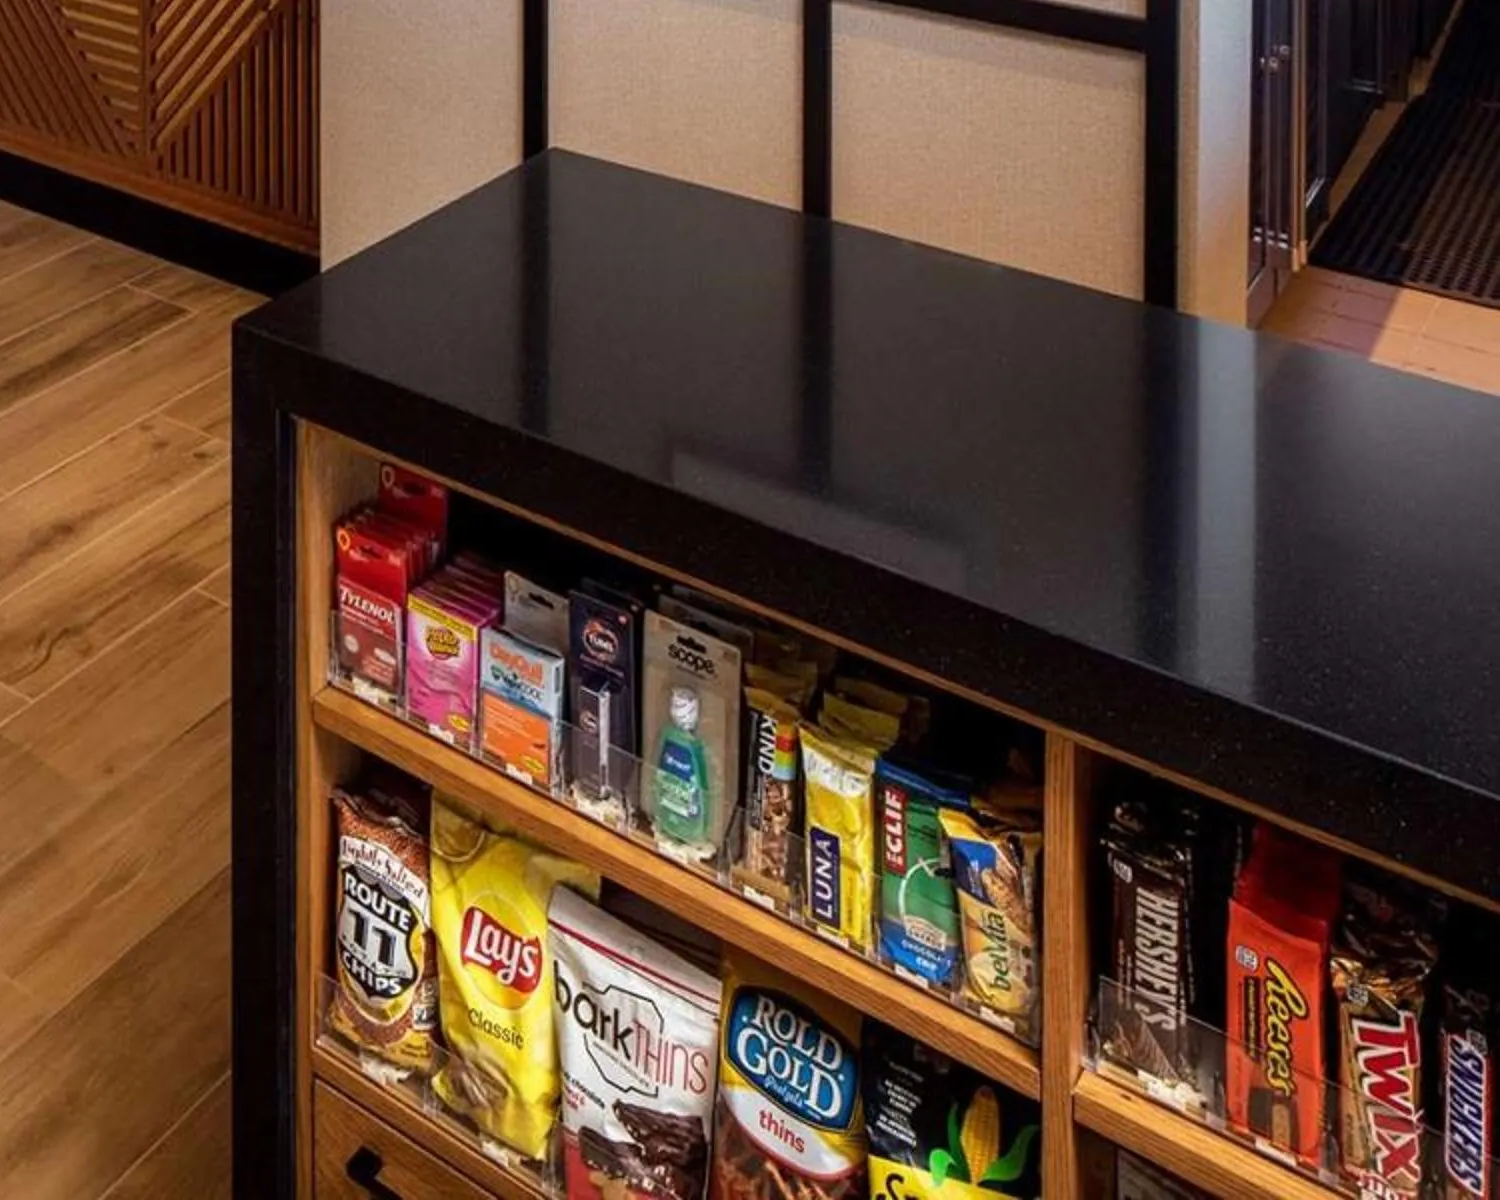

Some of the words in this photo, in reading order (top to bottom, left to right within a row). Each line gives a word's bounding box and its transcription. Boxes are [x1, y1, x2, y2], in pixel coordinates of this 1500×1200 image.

[339, 584, 395, 624] TYLENOL
[668, 644, 715, 676] scope
[758, 713, 778, 774] KIND
[345, 872, 412, 931] ROUTE
[815, 840, 833, 920] LUNA
[348, 908, 396, 967] 11
[465, 911, 538, 983] Lay's
[343, 950, 402, 995] CHIPS
[467, 1007, 524, 1050] Classic
[752, 996, 843, 1070] ROLD
[736, 1027, 843, 1119] GOLD
[1352, 1012, 1420, 1181] TWIX
[759, 1110, 805, 1153] thins
[1449, 1038, 1484, 1195] SNICKERS
